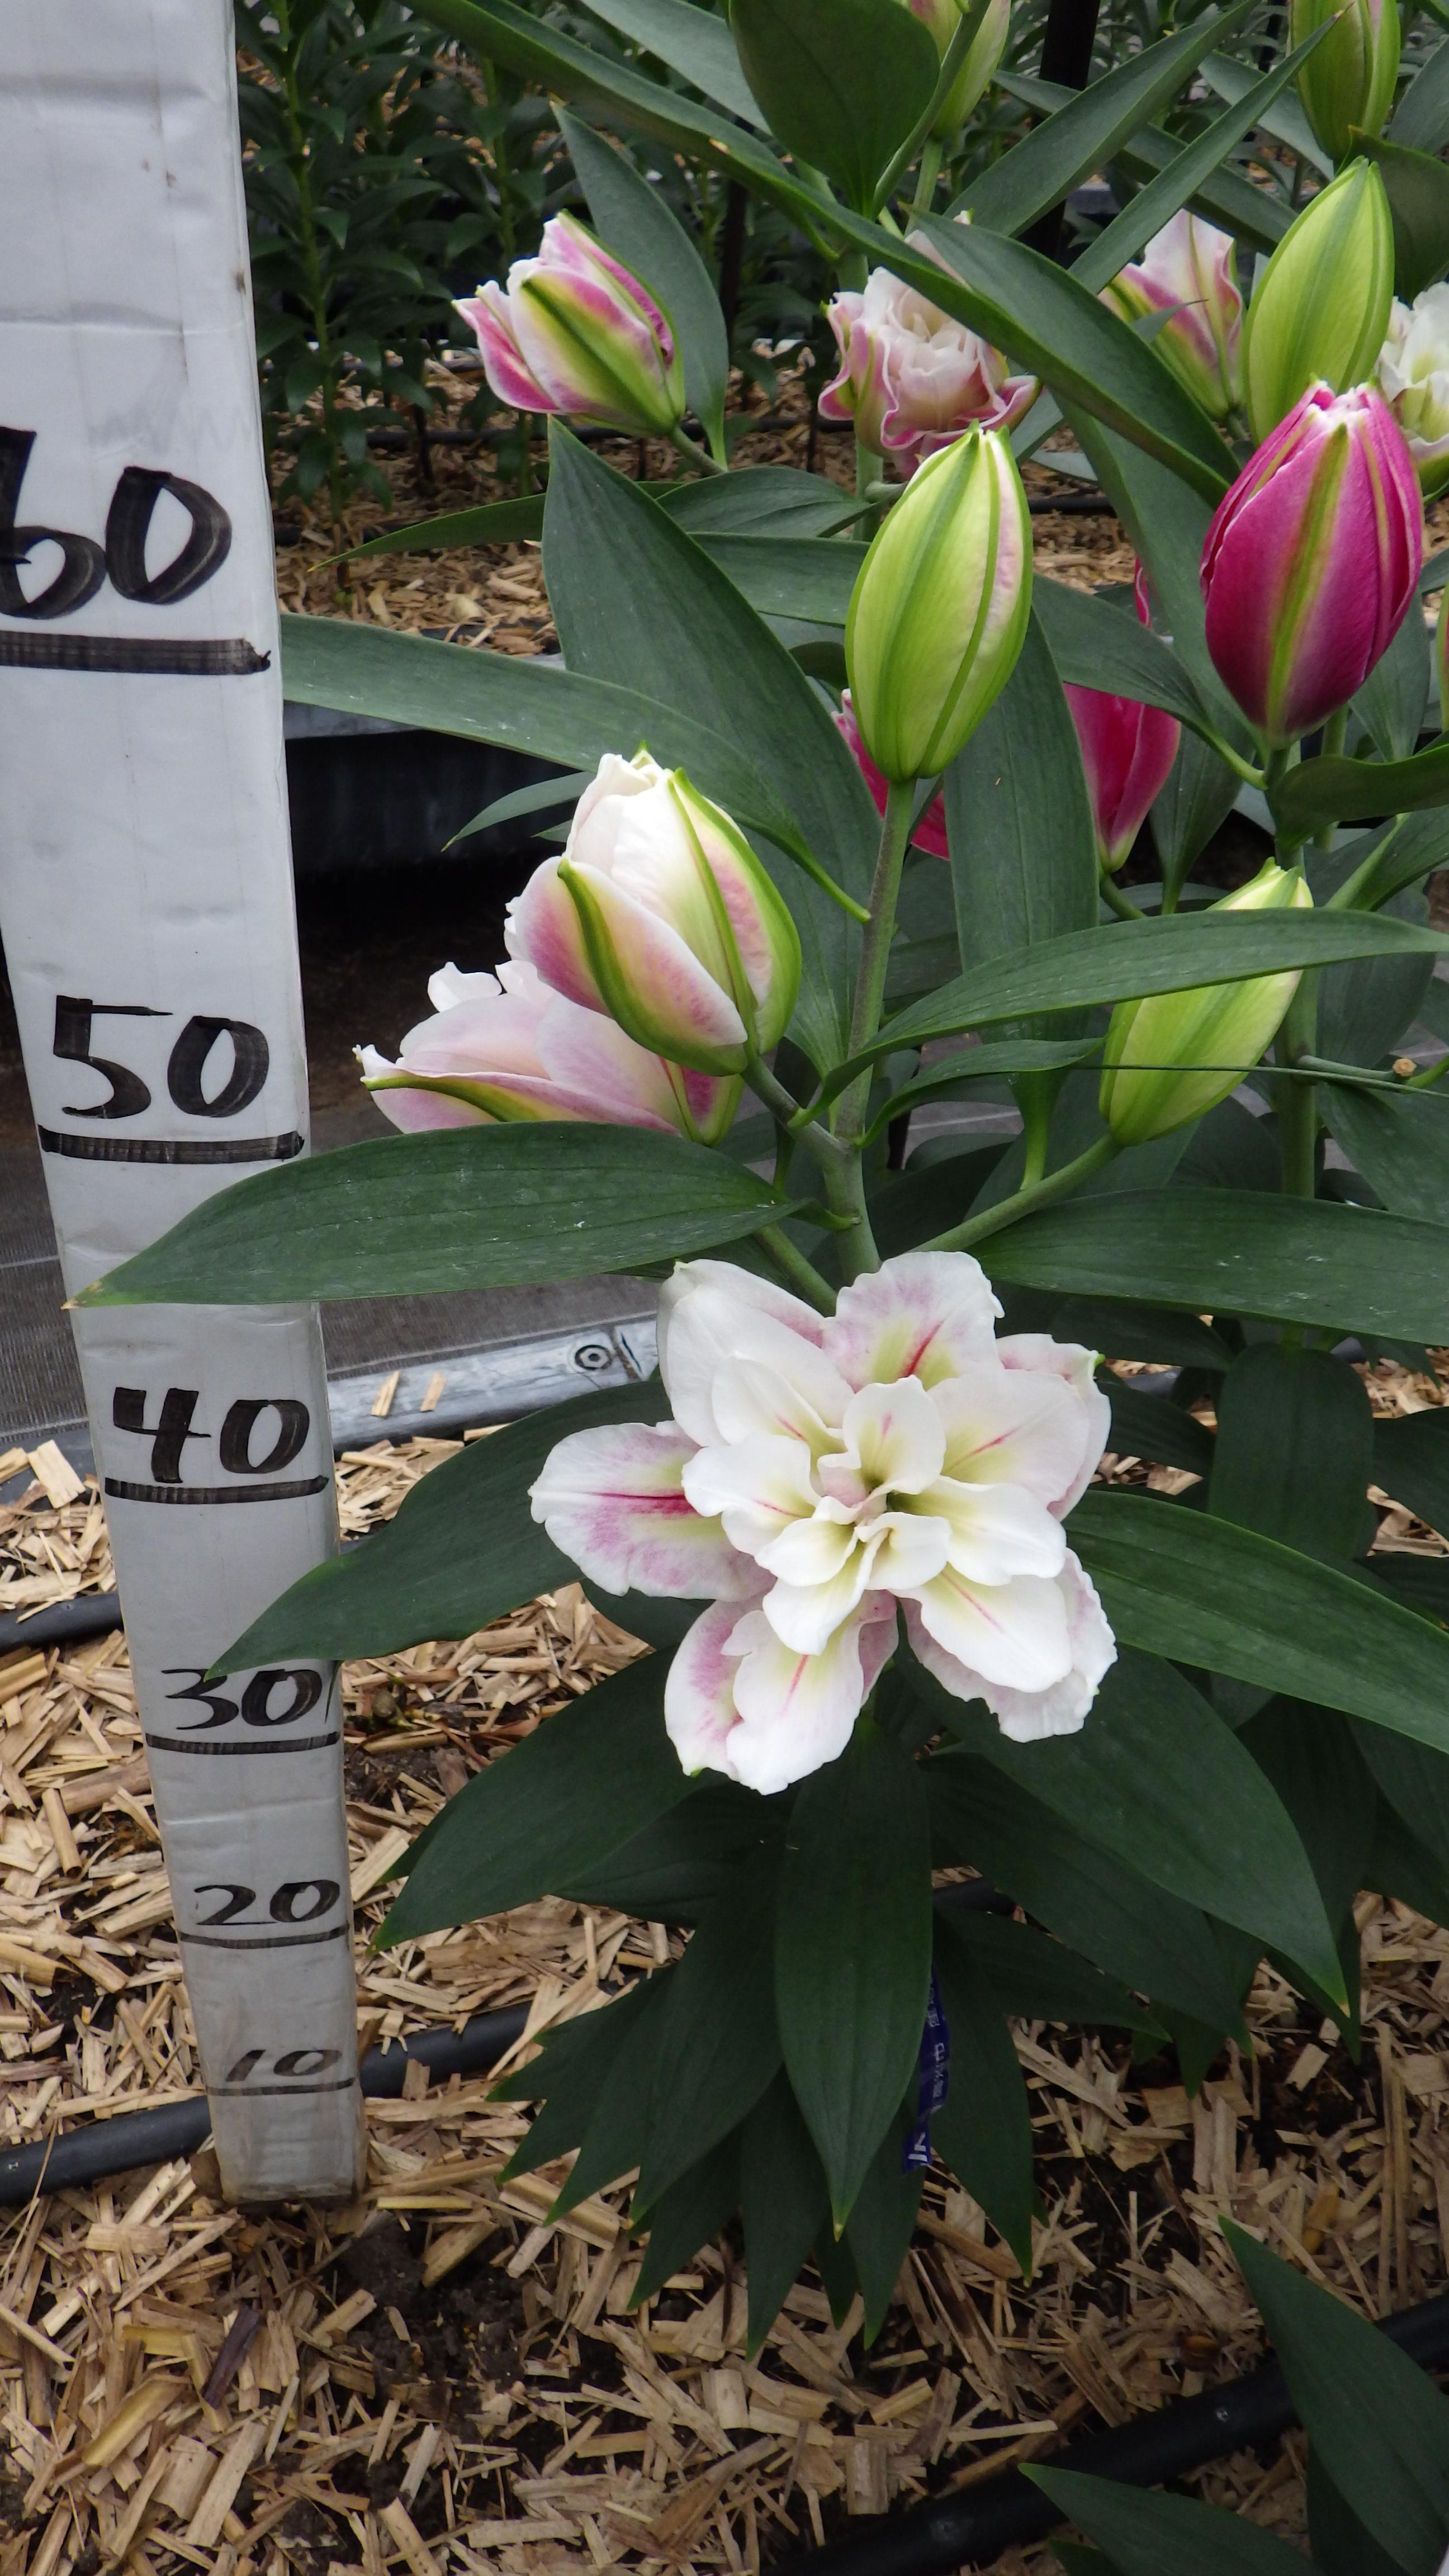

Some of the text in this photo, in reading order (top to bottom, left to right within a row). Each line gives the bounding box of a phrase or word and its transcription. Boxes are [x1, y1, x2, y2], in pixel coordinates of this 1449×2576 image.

[0, 427, 233, 619] 60
[53, 995, 269, 1119] 50
[113, 1387, 310, 1484] 40
[160, 1669, 323, 1730] 30
[194, 1879, 340, 1925] 20
[225, 2049, 342, 2082] 10
